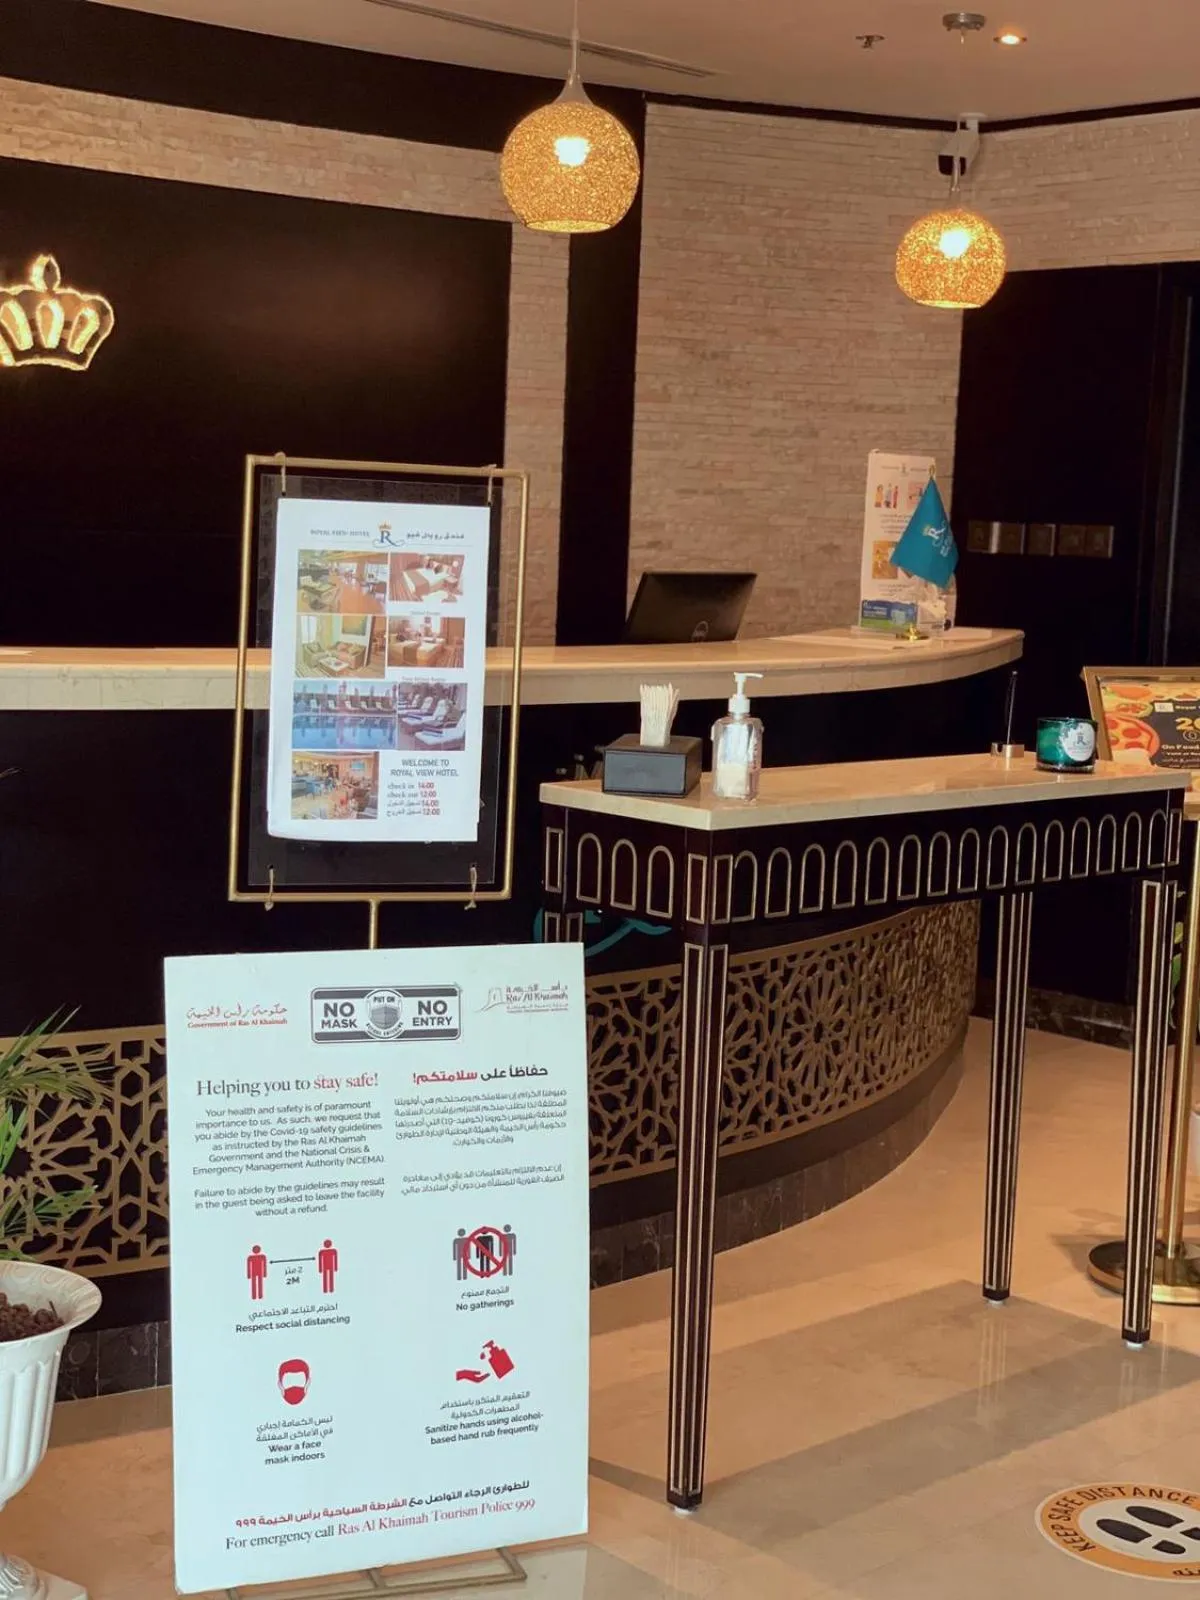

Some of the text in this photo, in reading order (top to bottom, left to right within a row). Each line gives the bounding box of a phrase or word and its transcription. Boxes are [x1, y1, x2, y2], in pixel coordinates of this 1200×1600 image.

[401, 759, 438, 767] WELCOME
[390, 769, 414, 777] ROYAL
[415, 769, 434, 777] VIEW
[323, 1002, 355, 1018] NO
[417, 1000, 448, 1015] NO
[321, 1018, 358, 1029] MASK
[412, 1016, 453, 1027] ENTRY
[413, 1070, 478, 1085] سلامتكم!
[480, 1068, 507, 1081] على
[196, 1072, 379, 1098] Helping you to stay safe!
[205, 1101, 371, 1118] Your health and safety is of paramount
[195, 1119, 247, 1131] importance
[249, 1119, 258, 1127] to
[276, 1117, 288, 1125] As
[329, 1113, 362, 1124] request
[363, 1111, 381, 1120] that
[194, 1123, 382, 1142] you abide by the Covid-19 safety guidelines
[225, 1140, 270, 1150] instructed
[271, 1139, 282, 1149] by
[284, 1138, 299, 1147] the
[301, 1137, 316, 1145] Ras
[318, 1136, 328, 1145] Al
[329, 1134, 366, 1144] Khaimah
[209, 1145, 370, 1163] Government and the National Crisis &
[192, 1155, 385, 1176] Emergency Management Authority (NCEMA)
[194, 1177, 385, 1198] Failure to abide by the guidelines may result
[195, 1188, 385, 1210] in the guest being asked to leave the facility
[255, 1207, 289, 1217] without
[298, 1203, 328, 1214] refund.
[286, 1277, 300, 1285] 2M
[456, 1299, 514, 1311] No gatherings
[236, 1315, 351, 1333] Respect social distancing
[425, 1411, 543, 1434] Sanitize hands using alcohol-
[430, 1423, 539, 1445] based hand rub frequently
[268, 1444, 292, 1453] Wear
[301, 1440, 321, 1449] face
[265, 1452, 326, 1465] mask indoors
[464, 1486, 491, 1498] الرجاء
[492, 1480, 530, 1495] للطوارئ
[369, 1498, 407, 1511] الشرطة
[408, 1497, 424, 1508] مع
[425, 1490, 463, 1505] التواصل
[226, 1498, 535, 1550] For emergency call Ras Al Khaimah Tourism Police 999
[258, 1513, 293, 1526] الخيمة
[1048, 1486, 1198, 1552] KEEP SAFE DISTANCE
